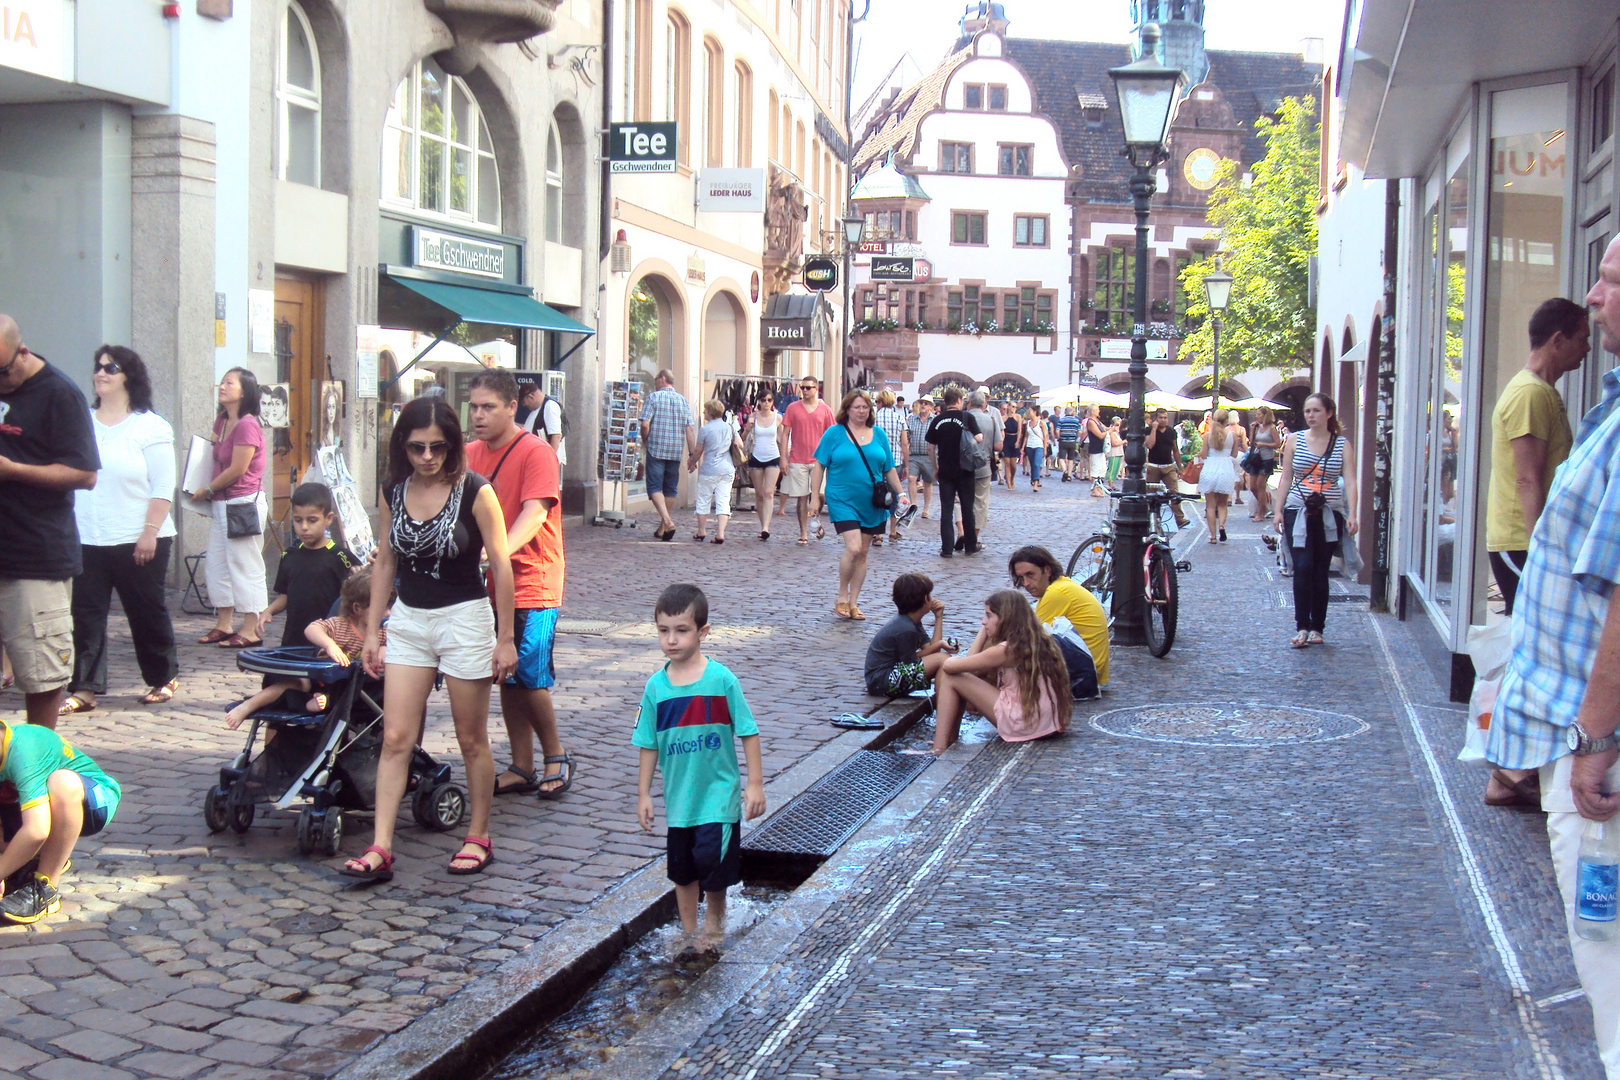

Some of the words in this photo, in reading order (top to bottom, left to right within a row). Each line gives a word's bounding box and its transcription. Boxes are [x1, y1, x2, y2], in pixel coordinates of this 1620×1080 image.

[619, 127, 667, 155] Tee
[612, 162, 672, 171] Gschwendner
[421, 237, 440, 263] Tee
[443, 241, 503, 273] Gschwendner
[256, 261, 264, 281] 2
[808, 269, 831, 279] LUSH
[768, 326, 804, 338] Hotel
[337, 551, 352, 569] F50
[666, 734, 704, 757] unicef
